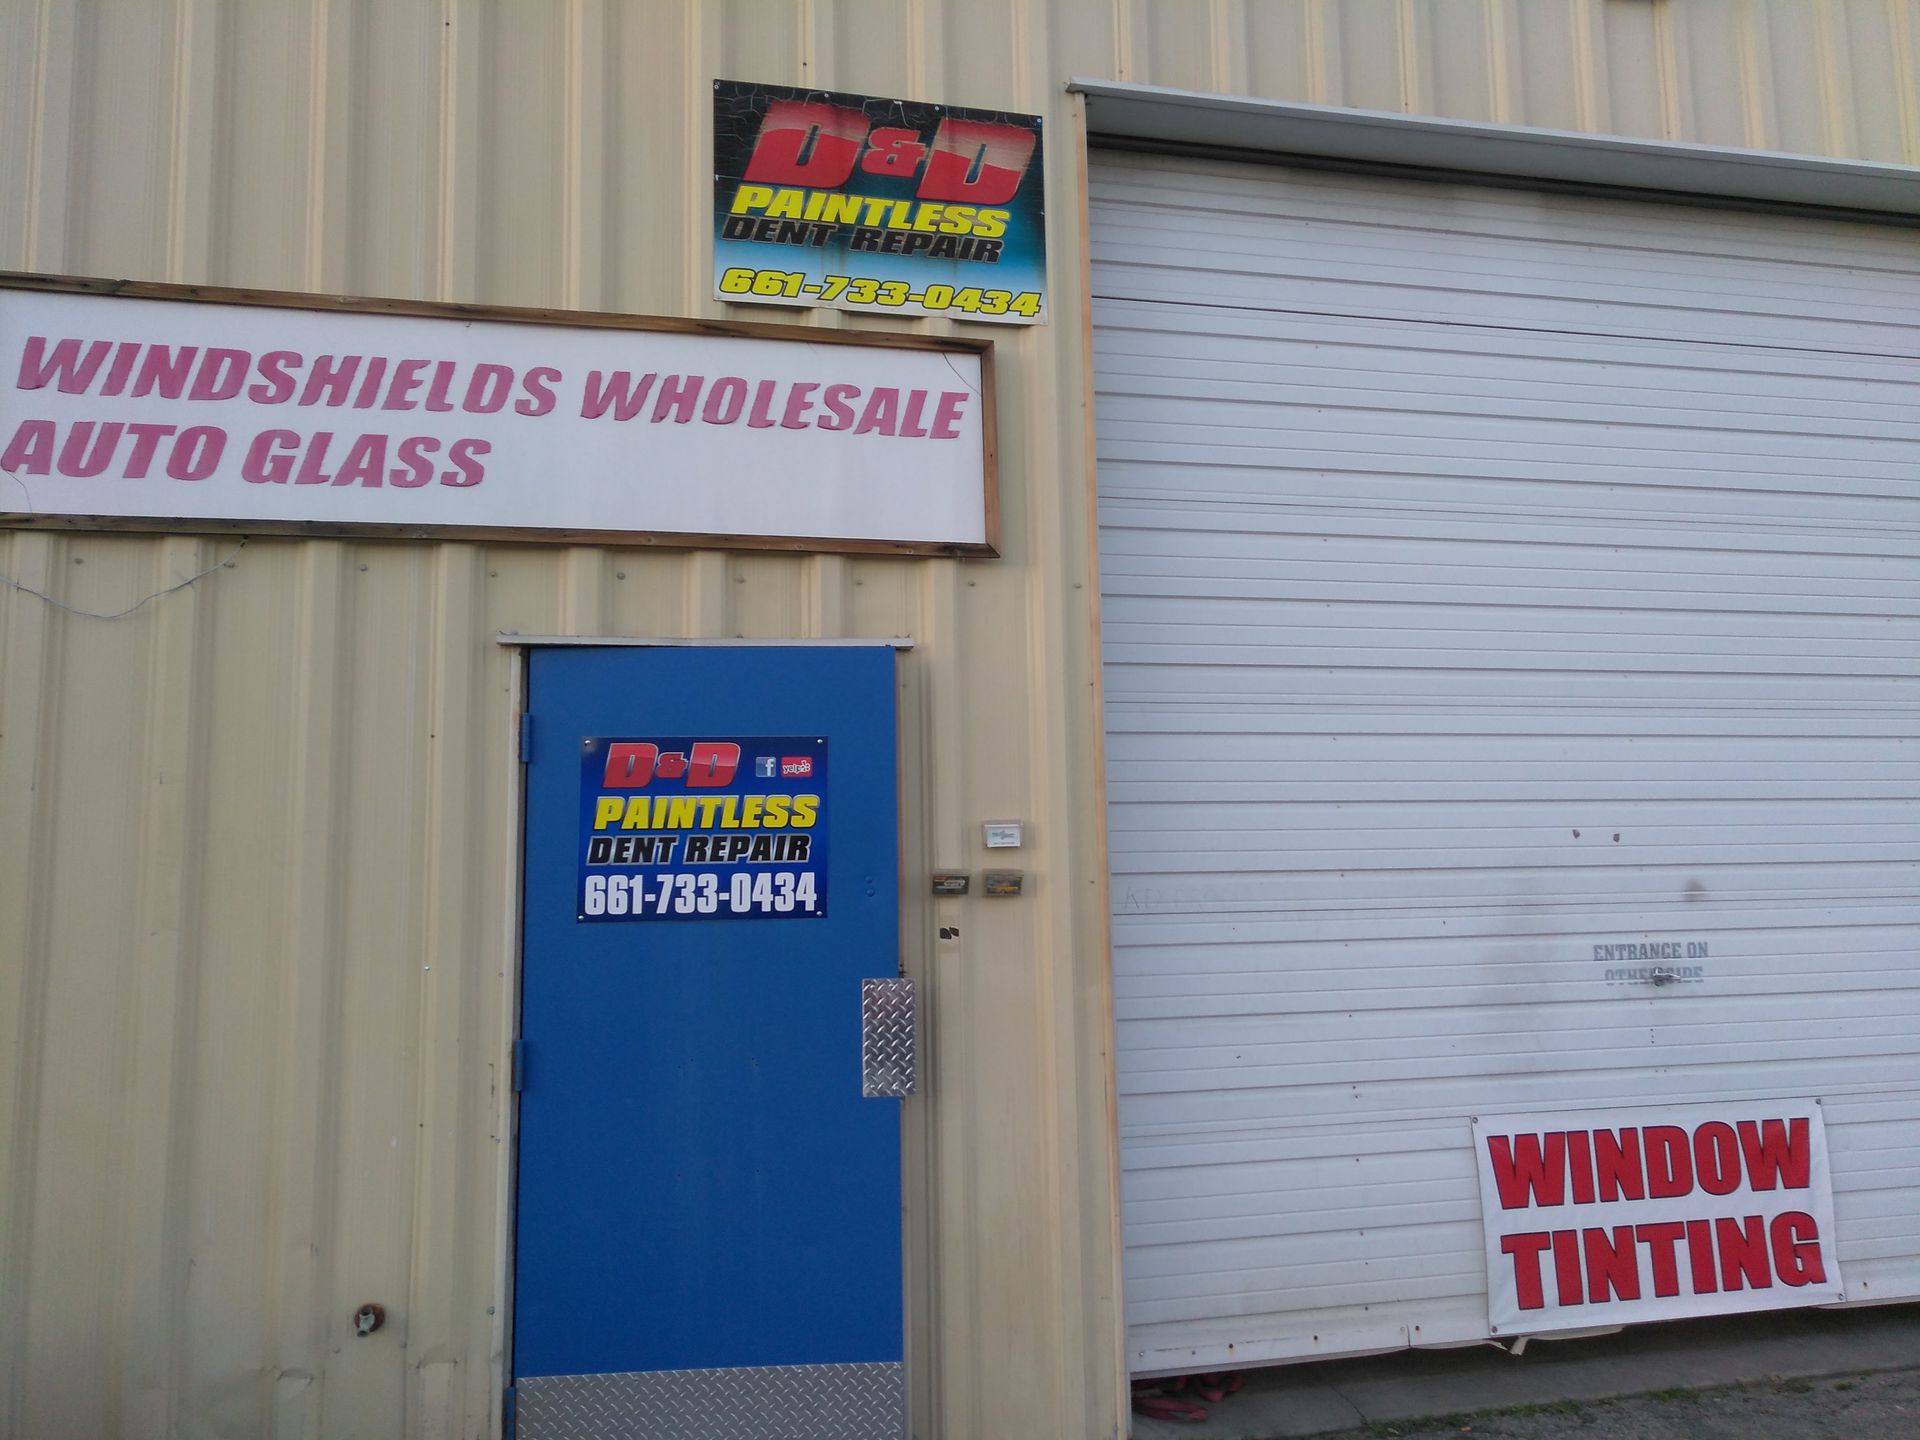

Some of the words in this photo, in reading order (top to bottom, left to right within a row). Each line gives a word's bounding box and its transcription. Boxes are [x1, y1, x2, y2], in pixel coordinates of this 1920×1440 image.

[743, 98, 1036, 205] D&D
[730, 184, 1011, 238] PAINTLESS
[721, 216, 838, 248] DENT
[849, 227, 1004, 264] REPAIR
[720, 267, 1042, 317] 661-733-0434
[16, 335, 563, 417] WINDSHIELDS
[580, 370, 969, 439] WHOLESALE
[0, 419, 229, 481] AUTO
[241, 429, 492, 488] GLASS
[602, 742, 741, 788] D&D
[593, 794, 821, 831] PAINTLESS
[586, 834, 680, 865] DENT
[683, 833, 812, 865] REPAIR
[584, 872, 817, 915] 661-733-0434
[1593, 942, 1682, 961] ENTRANCE
[1686, 942, 1709, 958] ON
[1487, 1117, 1810, 1209] WINDOW
[1501, 1211, 1827, 1311] TINTING
